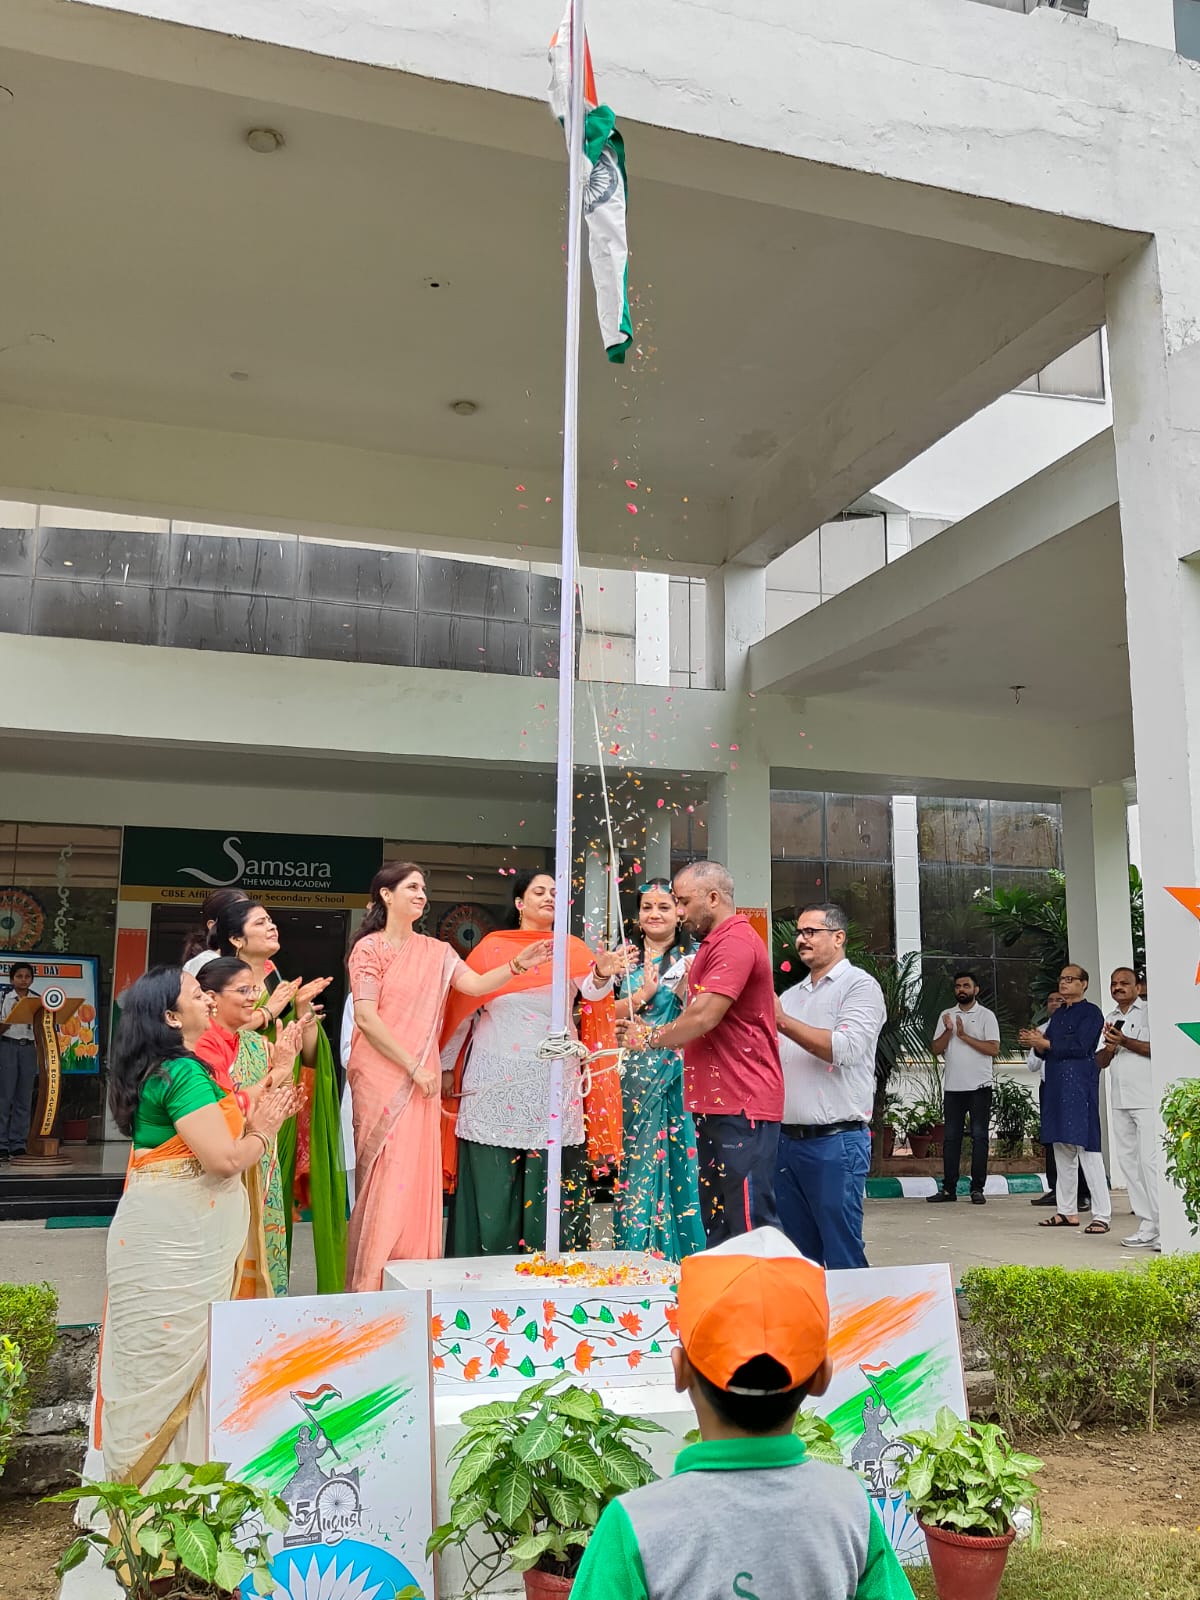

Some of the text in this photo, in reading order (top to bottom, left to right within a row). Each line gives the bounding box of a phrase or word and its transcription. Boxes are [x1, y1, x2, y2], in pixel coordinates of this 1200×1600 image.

[176, 836, 332, 886] Samsara
[242, 877, 332, 889] THE WORLD ACADEMY
[161, 889, 185, 898] CBSE
[265, 892, 312, 904] Secondary
[314, 894, 345, 904] School
[43, 965, 59, 975] DAY
[304, 1504, 371, 1544] August
